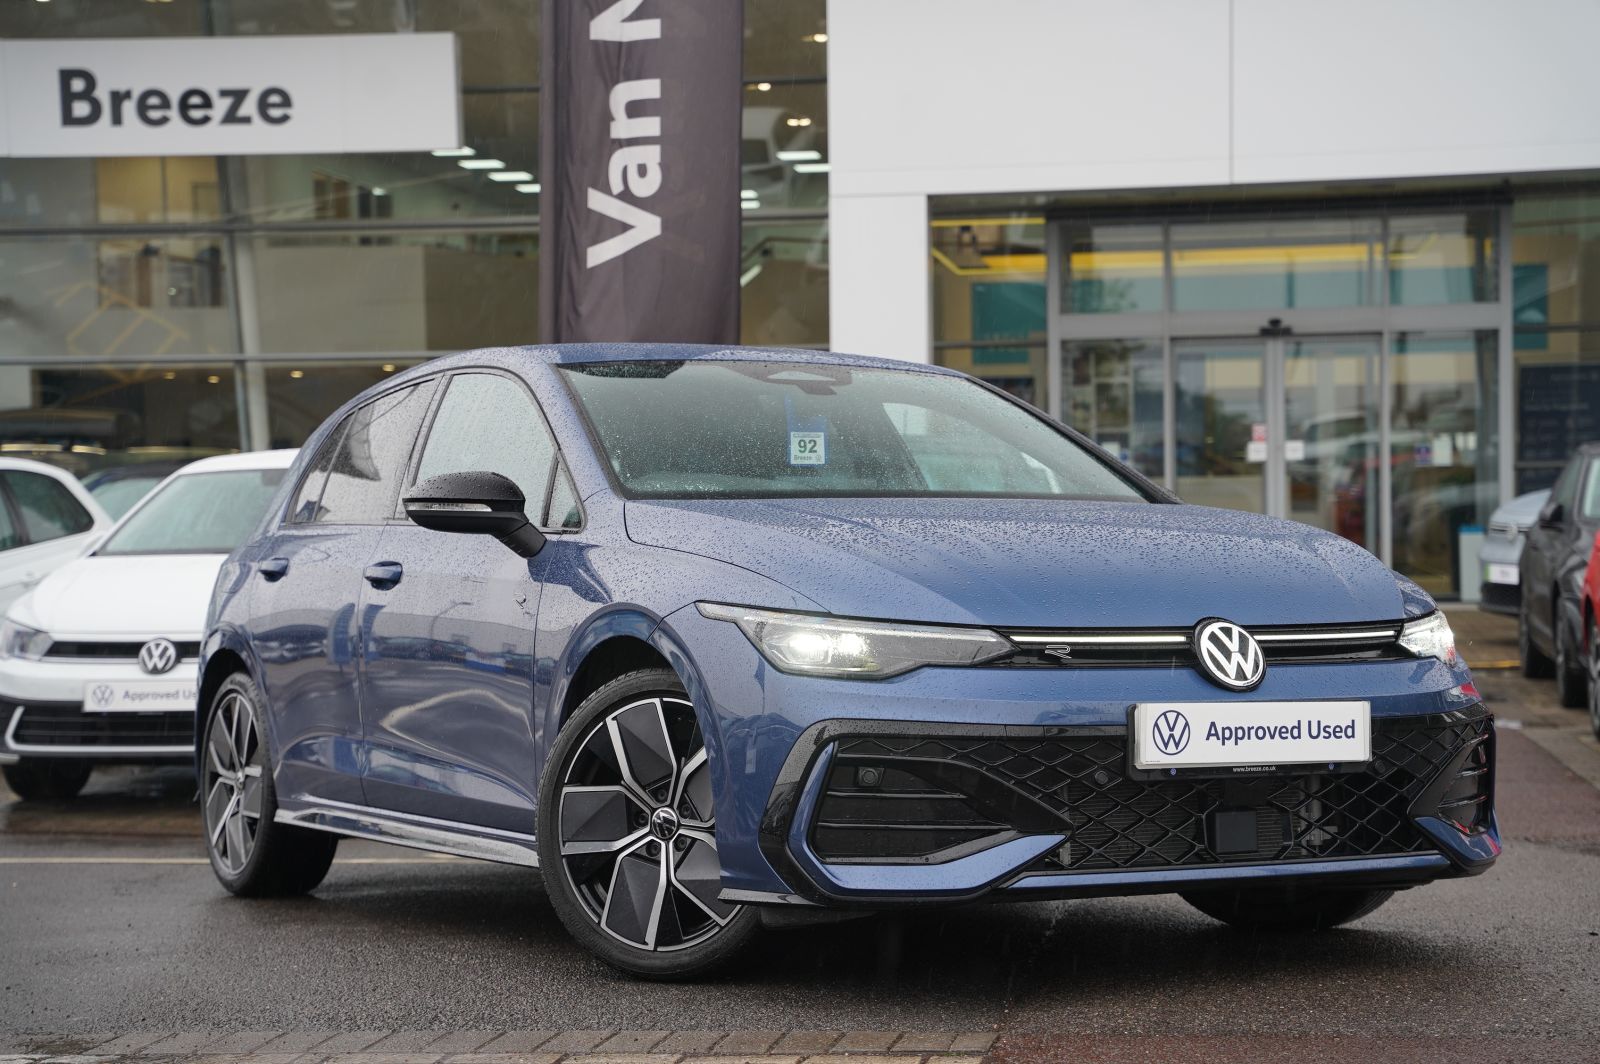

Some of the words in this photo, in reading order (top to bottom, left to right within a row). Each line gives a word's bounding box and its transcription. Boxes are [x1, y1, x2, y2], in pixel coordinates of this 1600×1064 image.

[58, 68, 293, 127] Breeze
[586, 78, 662, 269] Van
[798, 439, 817, 454] 92
[122, 690, 180, 702] Approved
[1205, 719, 1301, 746] Approved
[1307, 719, 1356, 740] Used
[1232, 765, 1276, 773] www.breeze.co.uk
